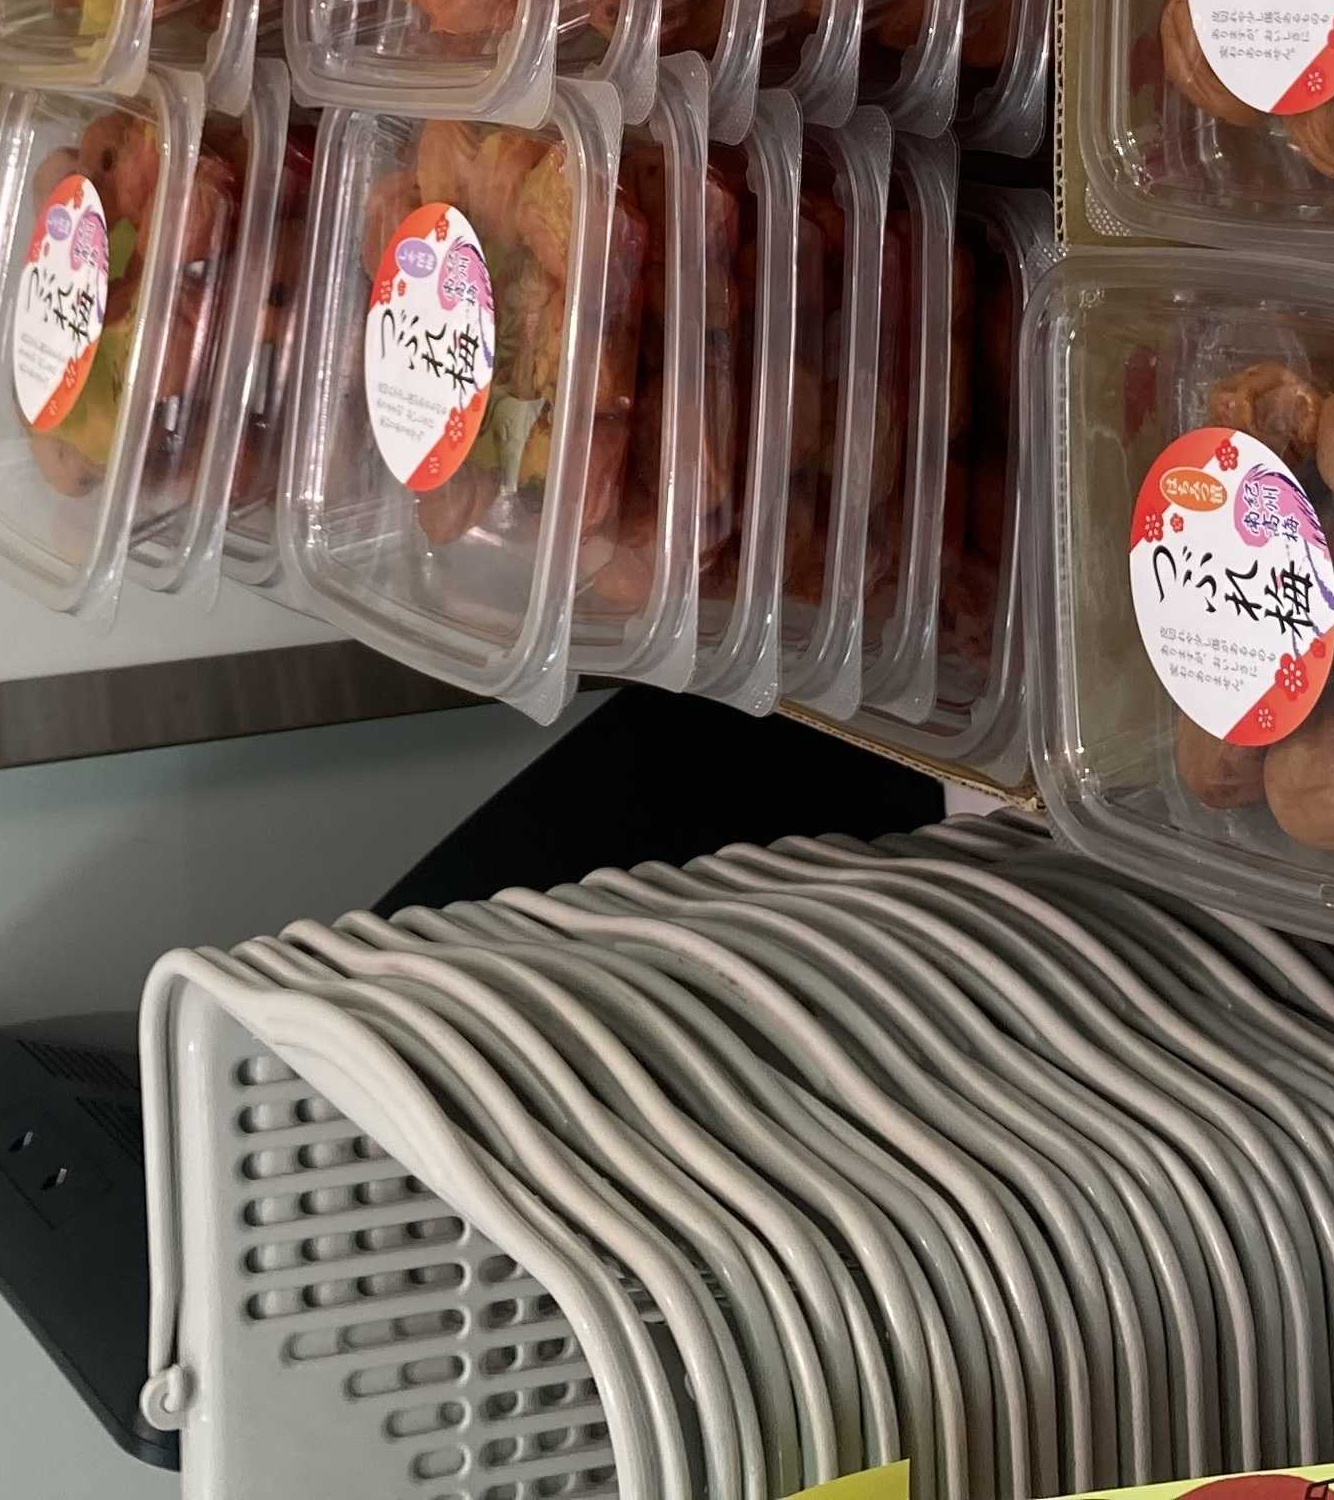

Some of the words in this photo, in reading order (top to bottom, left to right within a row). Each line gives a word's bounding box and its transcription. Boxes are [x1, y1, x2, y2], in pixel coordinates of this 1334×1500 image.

[379, 308, 480, 394] つぶれ梅
[1151, 545, 1314, 640] つぶれ梅
